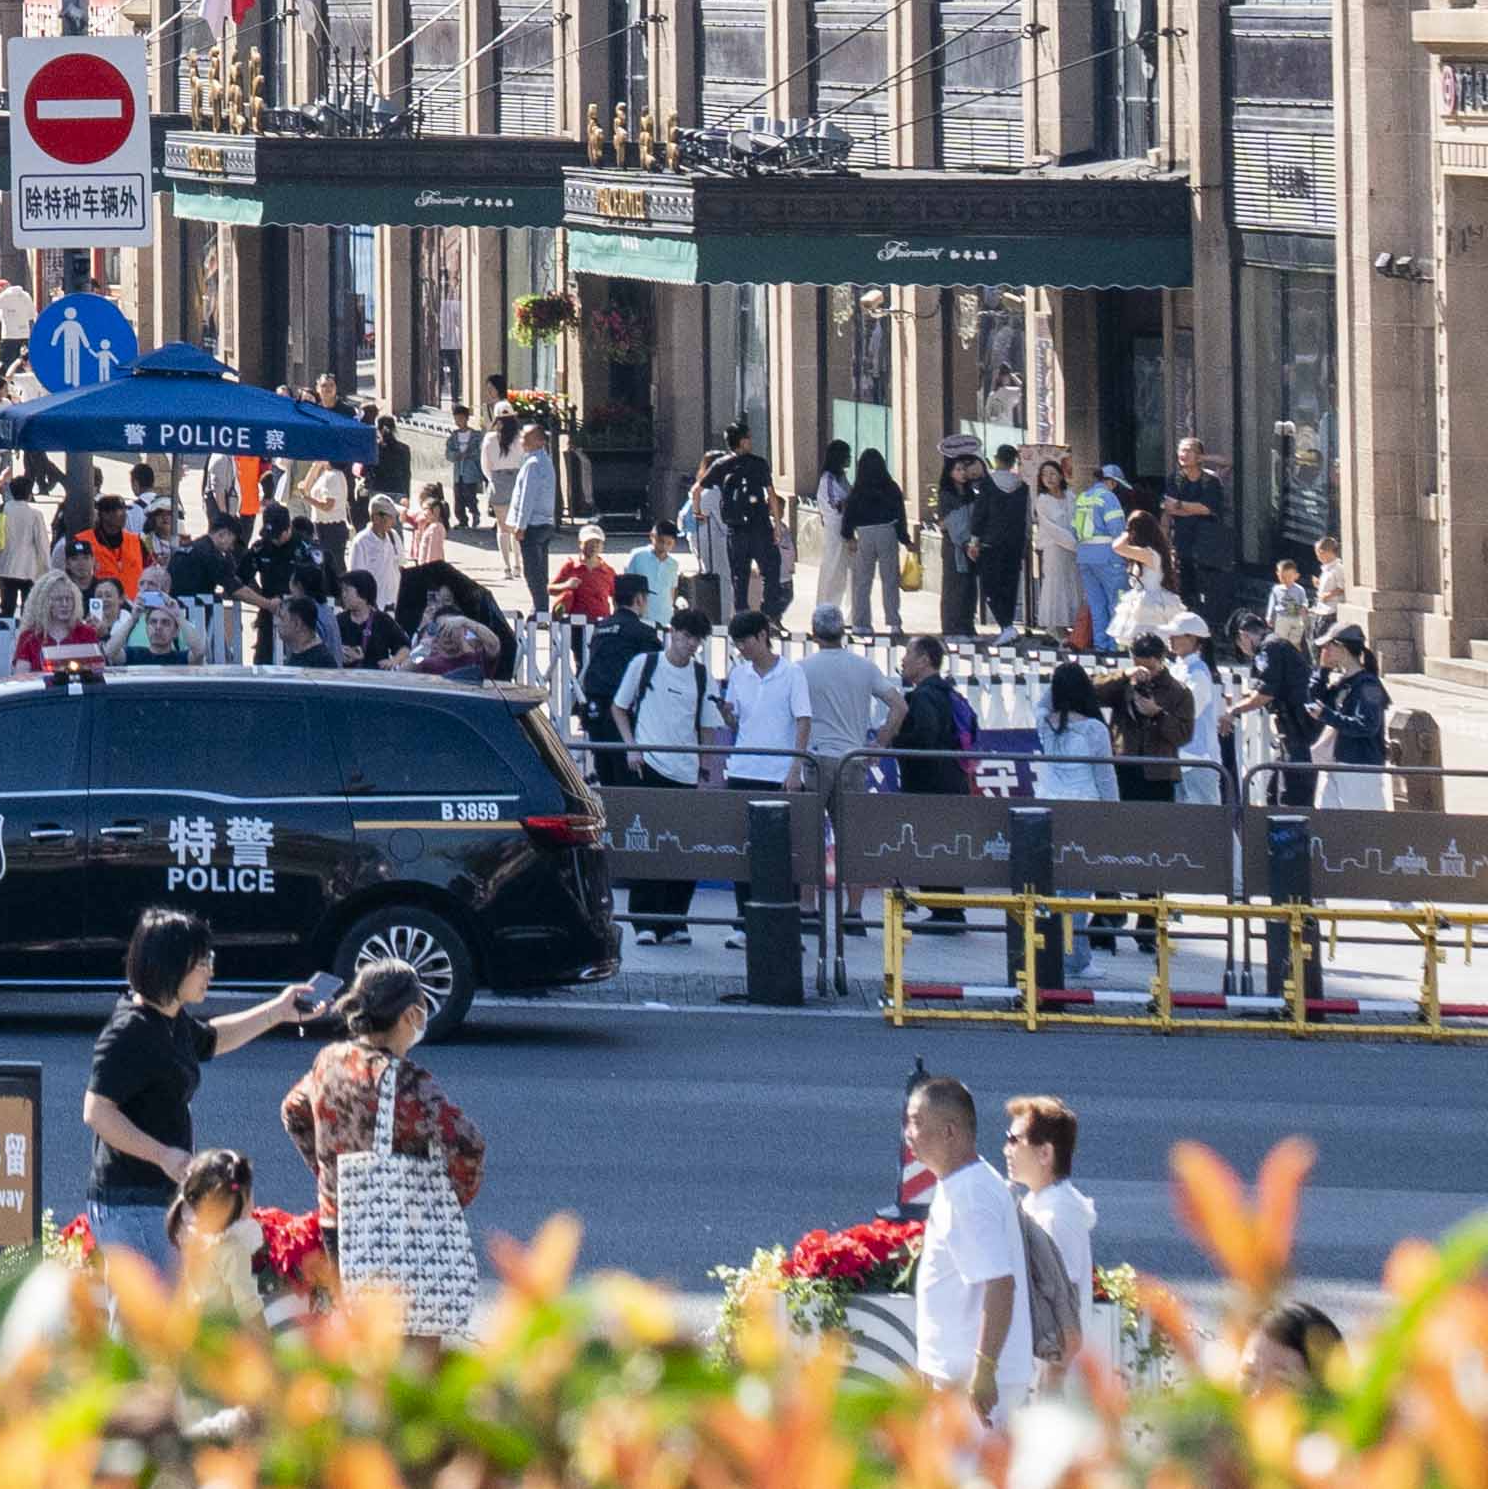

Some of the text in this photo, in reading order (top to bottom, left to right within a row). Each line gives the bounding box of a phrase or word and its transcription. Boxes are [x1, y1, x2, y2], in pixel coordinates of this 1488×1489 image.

[25, 185, 138, 220] 除特种车辆外
[123, 423, 286, 450] 警 POLICE 察
[441, 804, 499, 820] B 3859
[168, 816, 275, 867] 特警
[167, 869, 275, 893] POLICE
